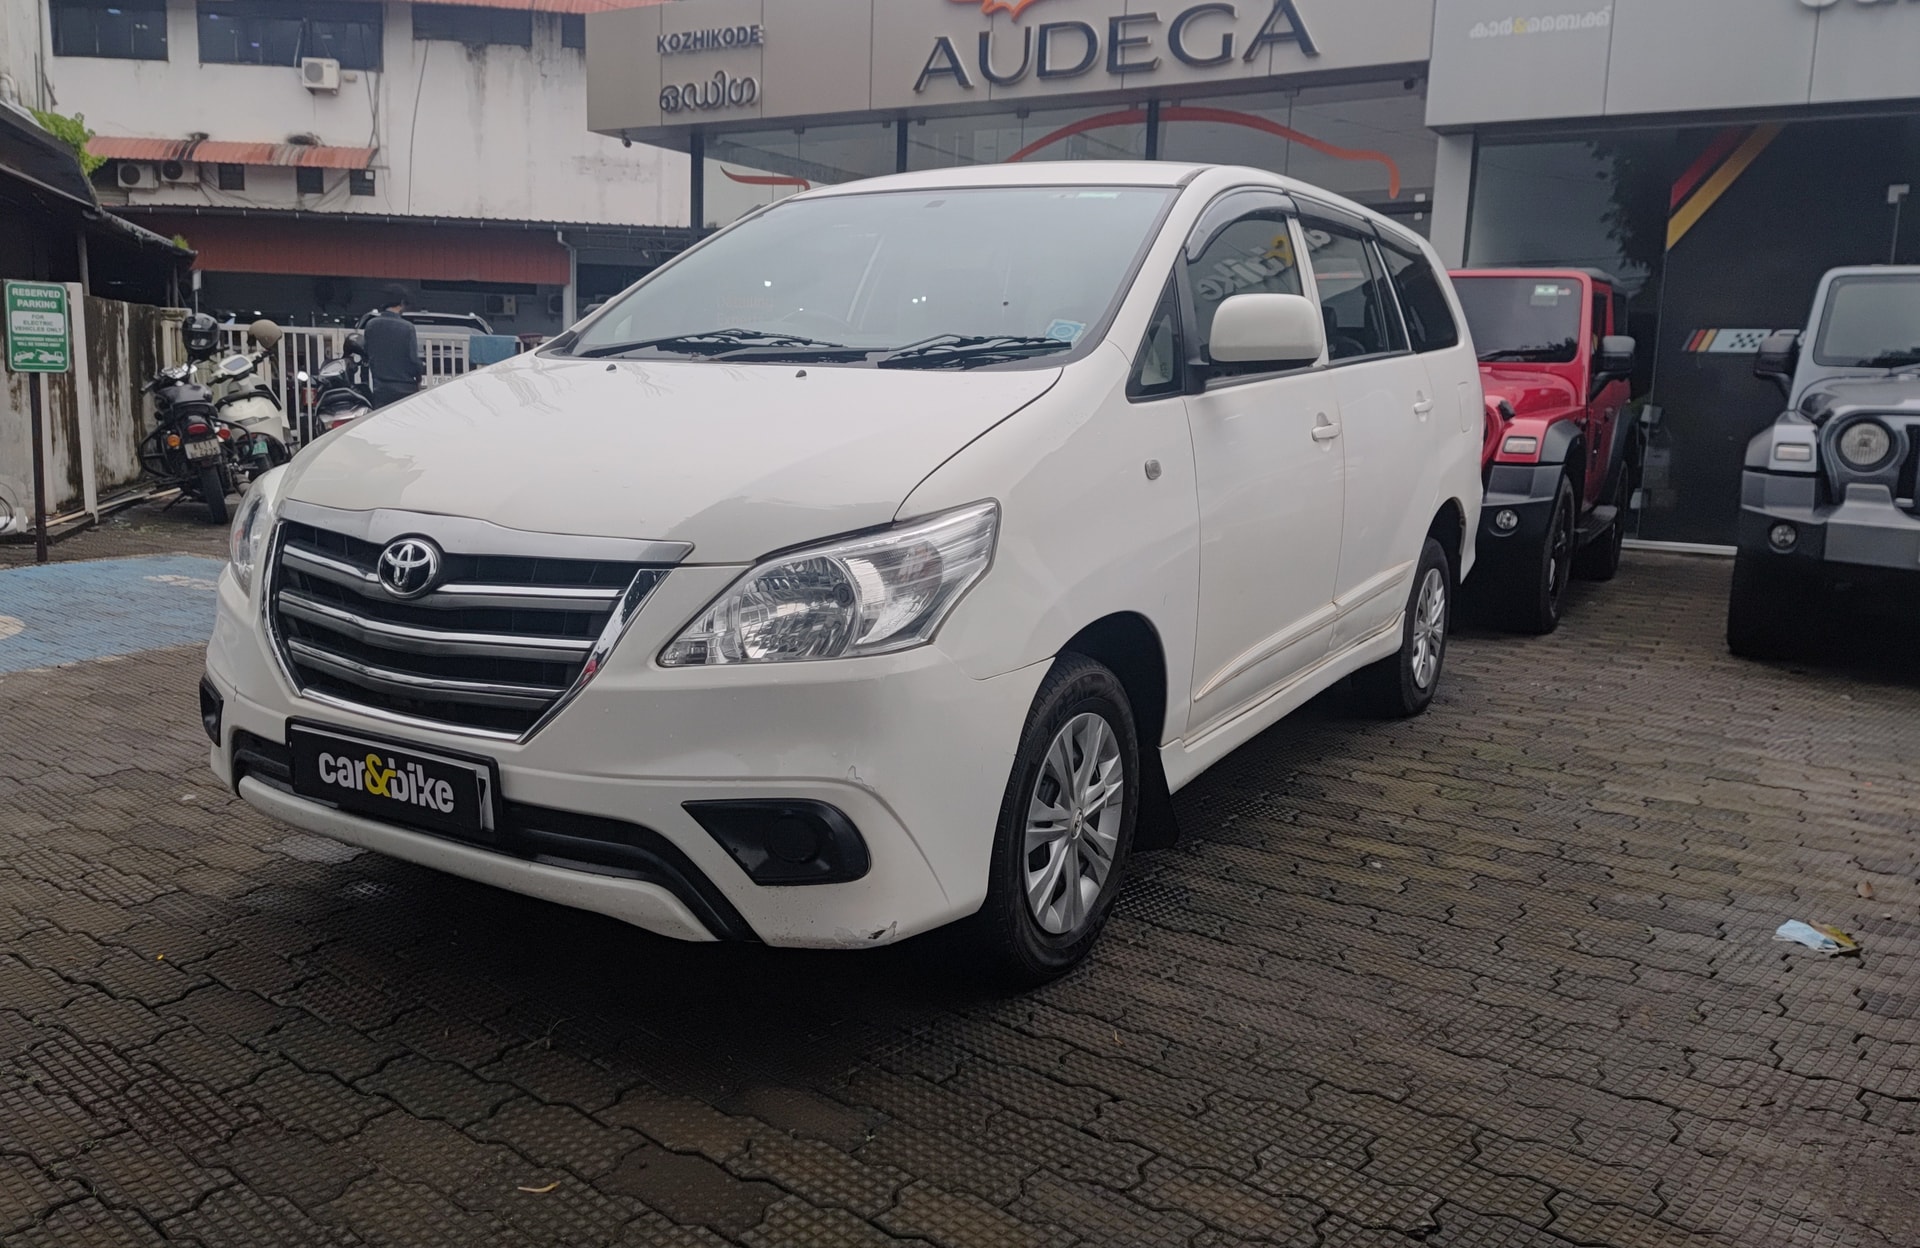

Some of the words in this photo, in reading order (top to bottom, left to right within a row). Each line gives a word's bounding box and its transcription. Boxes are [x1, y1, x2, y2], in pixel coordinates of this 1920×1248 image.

[657, 24, 764, 53] KOZHIKODE
[913, 0, 1320, 93] AUDEGA
[12, 287, 61, 298] RESERVED
[17, 299, 57, 309] PARKING
[318, 752, 455, 813] car&bike
